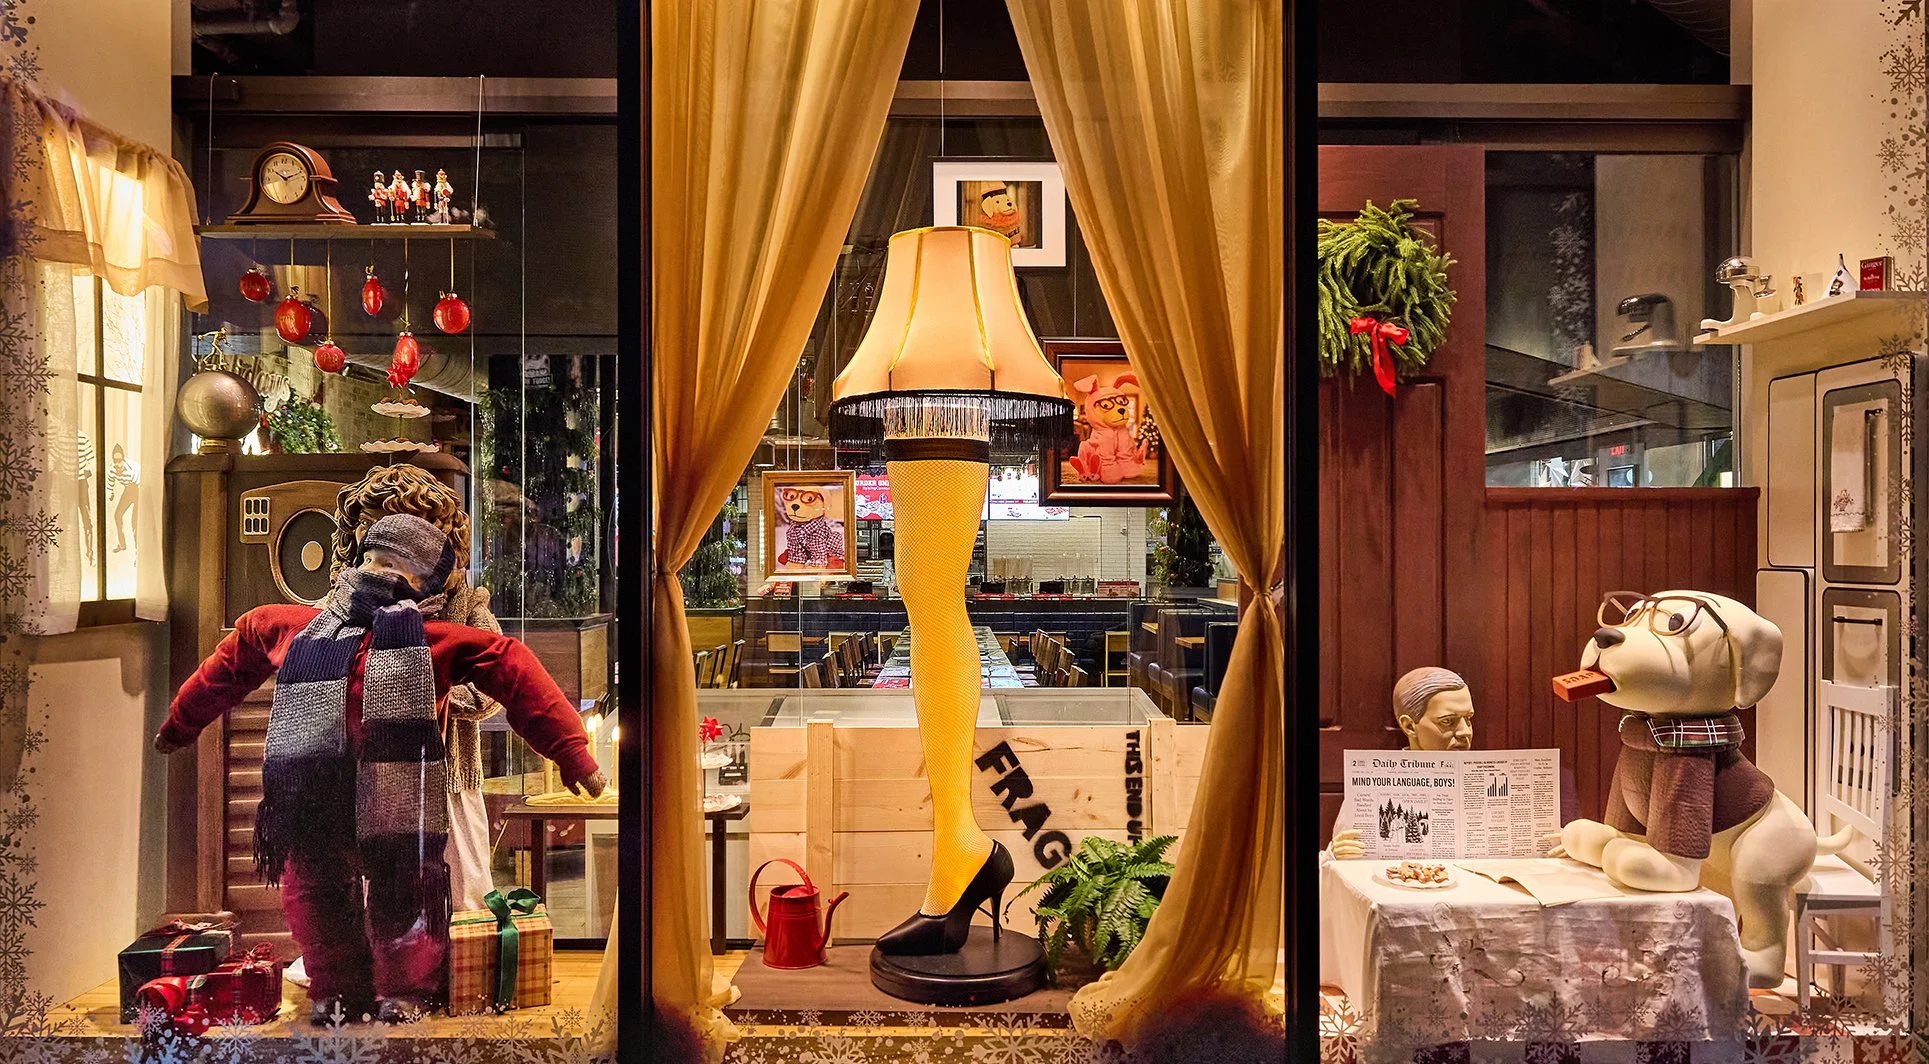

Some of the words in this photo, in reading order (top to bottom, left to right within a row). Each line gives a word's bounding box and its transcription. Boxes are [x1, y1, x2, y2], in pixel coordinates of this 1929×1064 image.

[1609, 445, 1625, 456] EXIT
[1562, 672, 1594, 685] SOAP
[1125, 730, 1143, 775] THIS
[1372, 758, 1398, 770] Daily
[1399, 758, 1436, 769] Tribune
[1352, 777, 1371, 786] MIND
[1372, 777, 1393, 786] YOUR
[1393, 777, 1432, 788] LANGUAGE,
[1434, 778, 1455, 788] BOYS!
[1125, 777, 1143, 819] END
[974, 740, 1073, 870] FRAG
